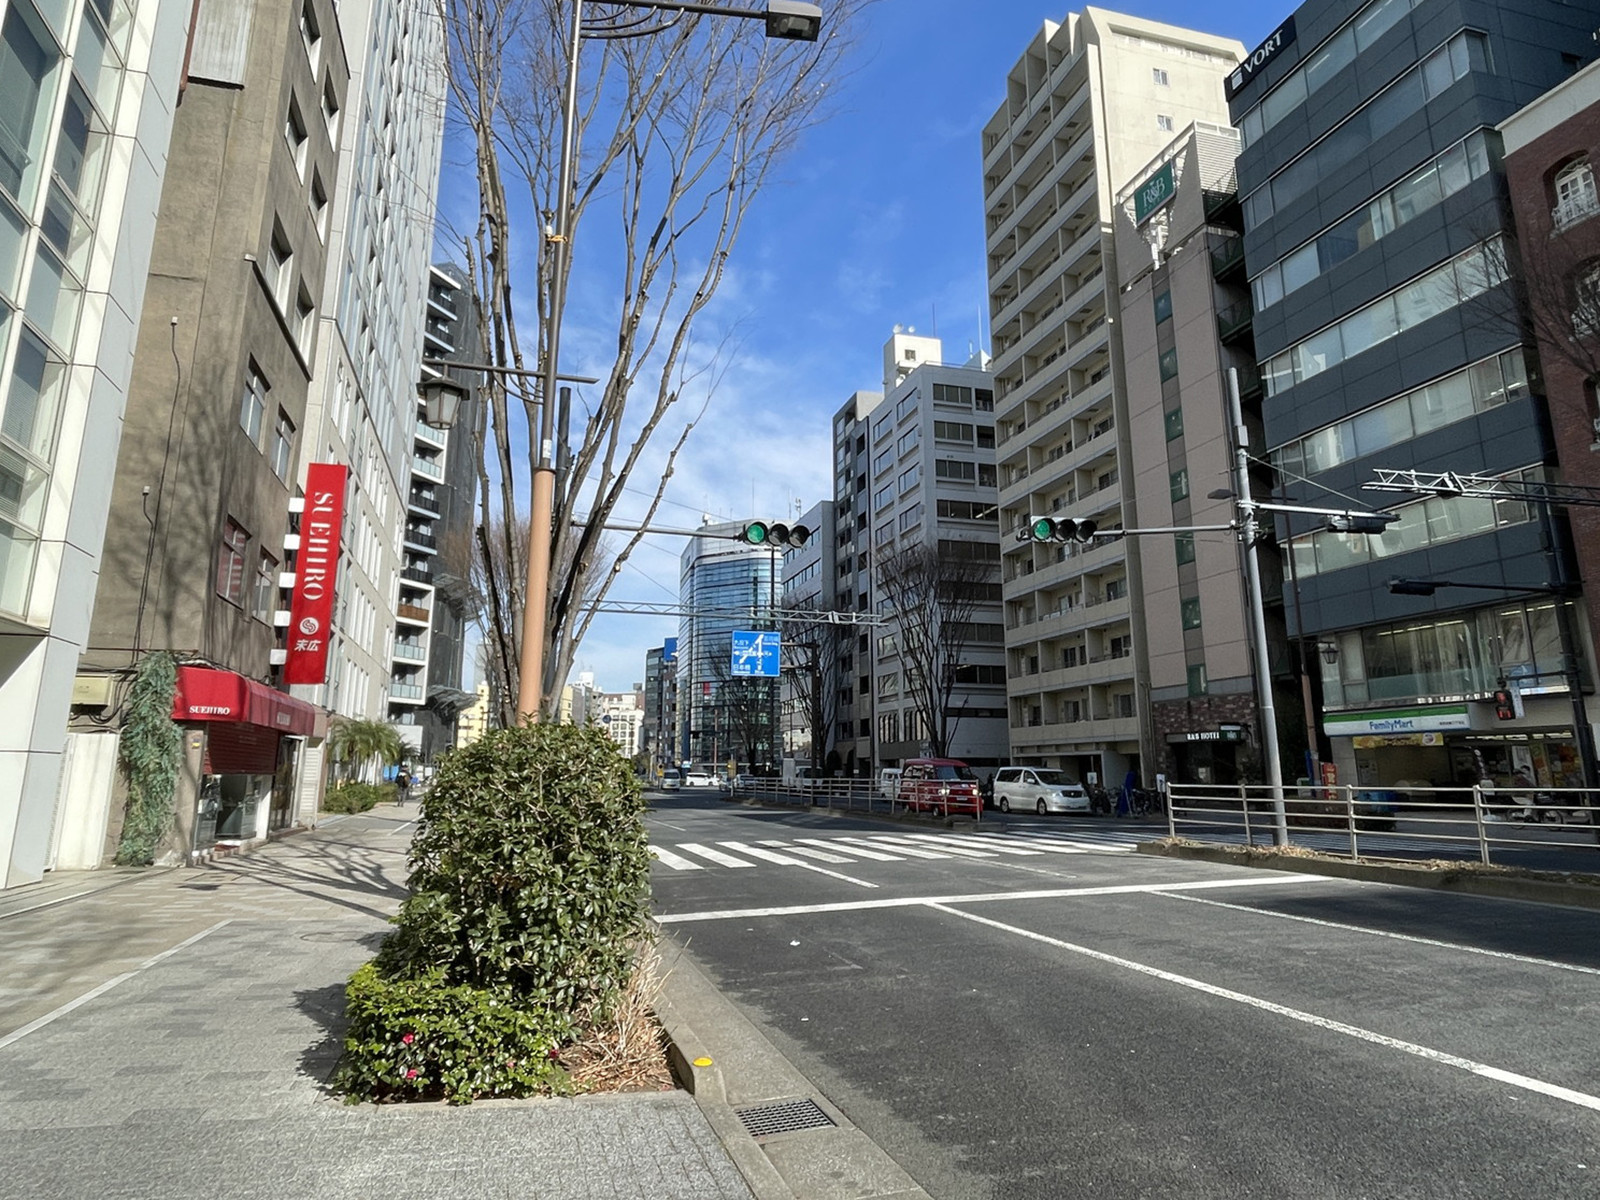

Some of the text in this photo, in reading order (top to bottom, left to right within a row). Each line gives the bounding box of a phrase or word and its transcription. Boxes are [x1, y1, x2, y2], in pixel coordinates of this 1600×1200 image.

[1243, 29, 1283, 73] VORT
[1142, 177, 1165, 207] R&B
[302, 492, 334, 601] SUEHIRO
[294, 639, 322, 652] 末広
[189, 705, 231, 716] SUEHIRO
[1369, 719, 1415, 731] FamilyMart
